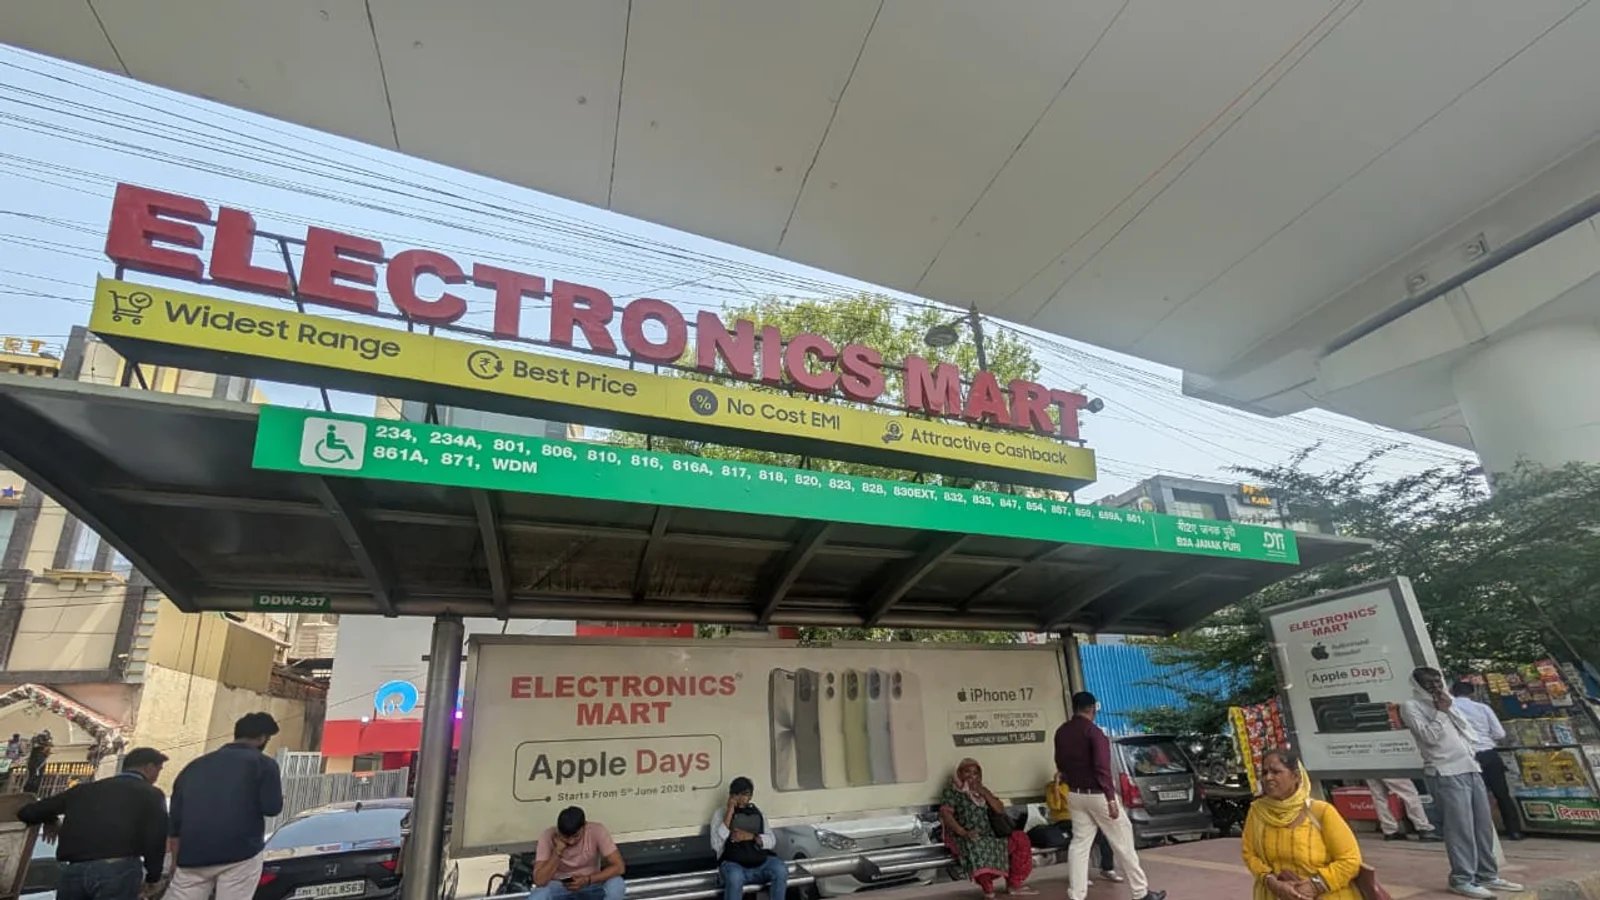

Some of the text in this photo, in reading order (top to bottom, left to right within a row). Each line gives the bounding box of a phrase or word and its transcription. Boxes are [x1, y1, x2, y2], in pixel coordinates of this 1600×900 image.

[104, 182, 1088, 441] ELECTRONICS MART
[165, 300, 401, 360] Widest Range
[513, 360, 638, 396] Best Price
[727, 398, 841, 430] No Cost EMI
[373, 446, 537, 474] 861A, 871, WDM
[911, 428, 1068, 466] Attractive Cashback
[375, 425, 417, 443] 234,
[429, 431, 482, 450] 234A,
[493, 439, 531, 456] 801,
[541, 444, 577, 460] 806,
[587, 450, 621, 465] 810,
[631, 455, 664, 470] 816,
[672, 460, 713, 476] 816A,
[721, 465, 751, 480] 817,
[759, 470, 788, 484] 818,
[794, 474, 822, 488] 820,
[828, 479, 855, 492] 823,
[893, 486, 938, 501] 830EXT,
[1194, 537, 1222, 550] JANAK
[259, 595, 327, 607] DDW-237
[1289, 606, 1377, 633] ELECTRONICS
[1312, 621, 1349, 638] MART
[511, 675, 736, 699] ELECTRONICS
[1311, 670, 1348, 685] Apple
[1350, 664, 1386, 680] Days
[970, 687, 1034, 702] iPhone 17
[576, 701, 672, 726] MART
[528, 749, 711, 785] Apple Days
[557, 791, 590, 801] Starts
[592, 789, 618, 800] From
[635, 786, 658, 796] June
